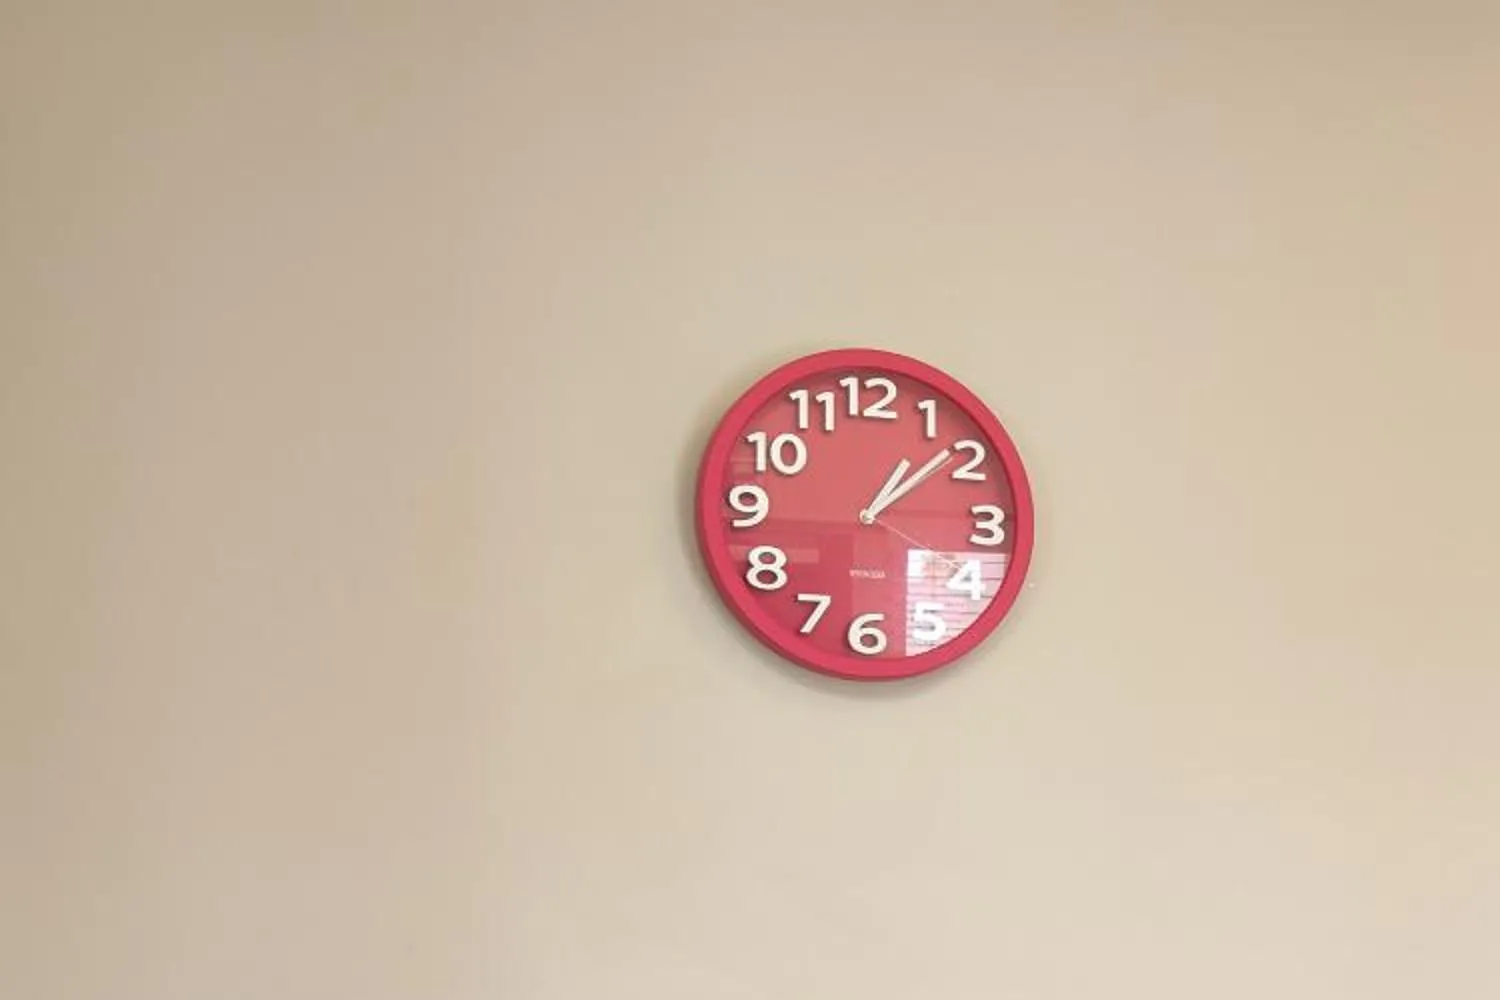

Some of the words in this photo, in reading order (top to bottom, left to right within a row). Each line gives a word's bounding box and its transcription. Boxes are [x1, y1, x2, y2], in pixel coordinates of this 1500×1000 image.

[789, 390, 835, 431] 11
[840, 376, 897, 419] 12
[917, 399, 937, 438] 1
[746, 431, 808, 475] 10
[951, 439, 987, 481] 2
[728, 485, 769, 527] 9
[969, 505, 1005, 546] 3
[745, 546, 788, 590] 8
[946, 559, 986, 601] 4
[796, 593, 832, 633] 7
[847, 613, 887, 655] 6
[911, 602, 946, 642] 5
